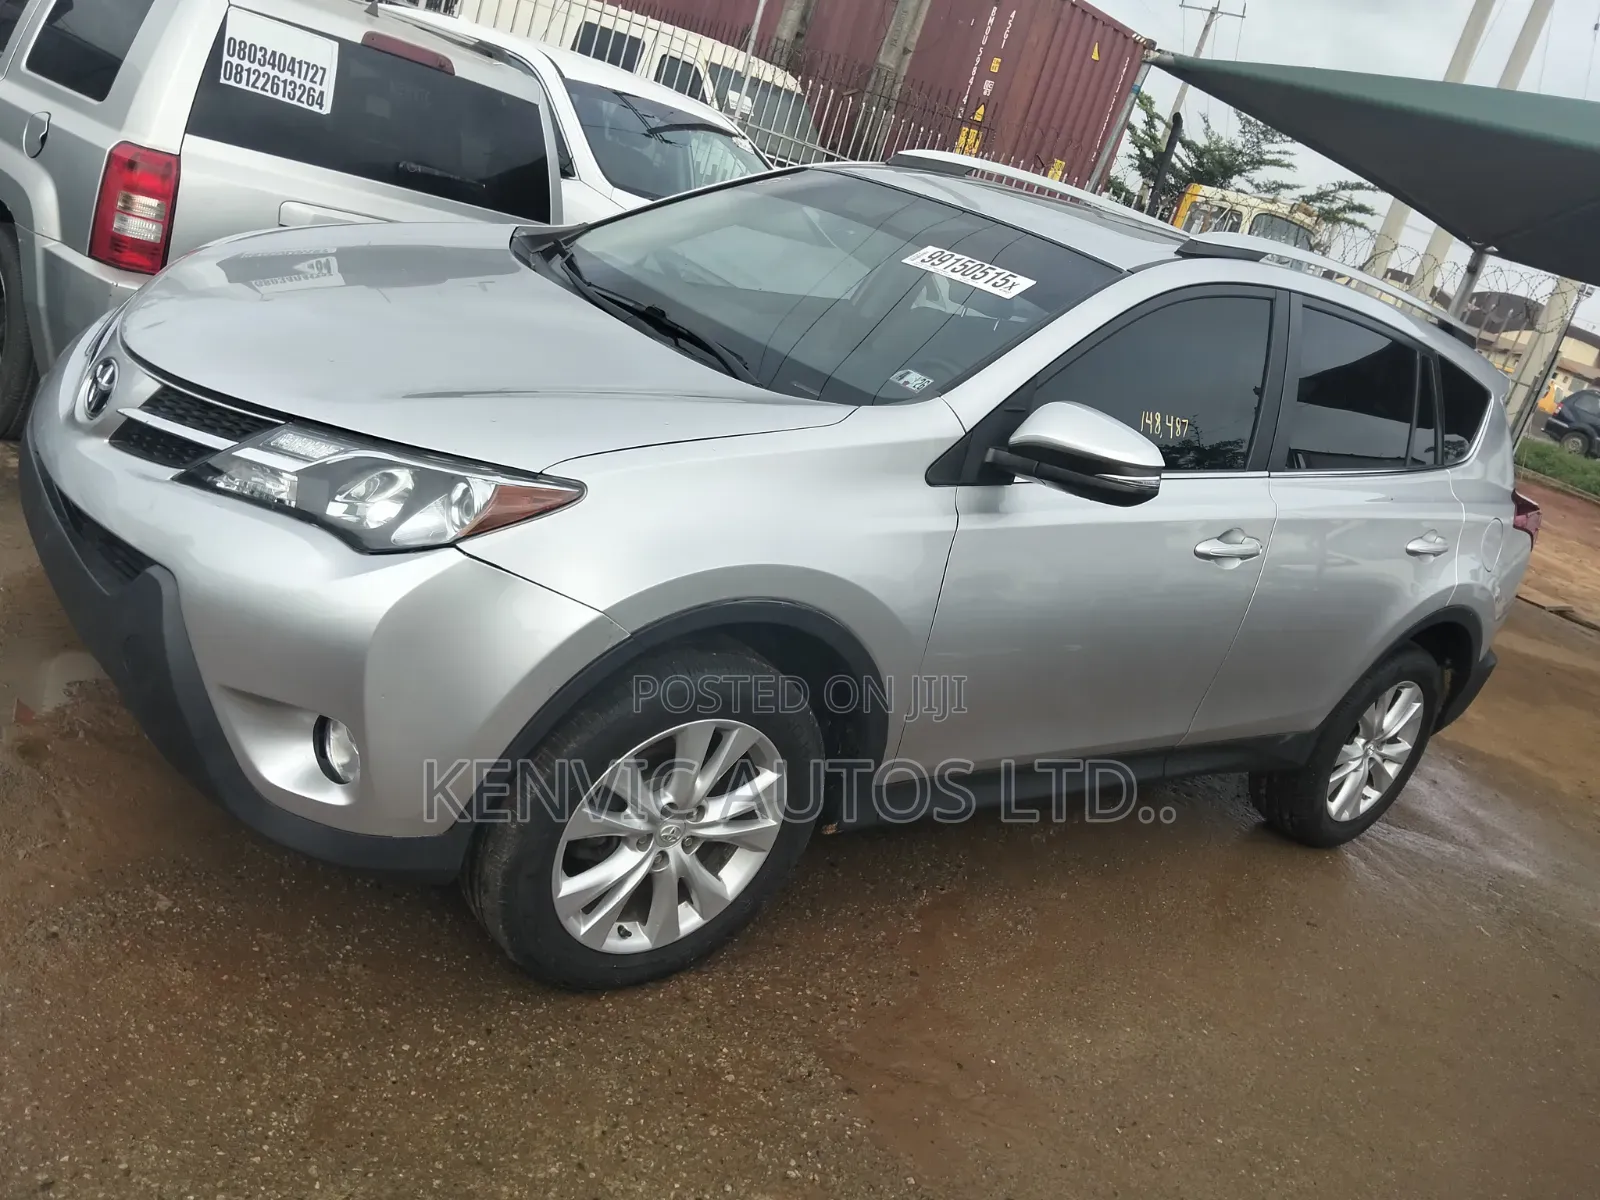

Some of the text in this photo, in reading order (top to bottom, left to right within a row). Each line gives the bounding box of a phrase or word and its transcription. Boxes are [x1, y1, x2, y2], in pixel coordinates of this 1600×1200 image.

[982, 6, 998, 45] BMOU
[226, 37, 327, 87] 08034041727
[222, 60, 325, 110] 08122613264
[1140, 410, 1189, 439] 148,487
